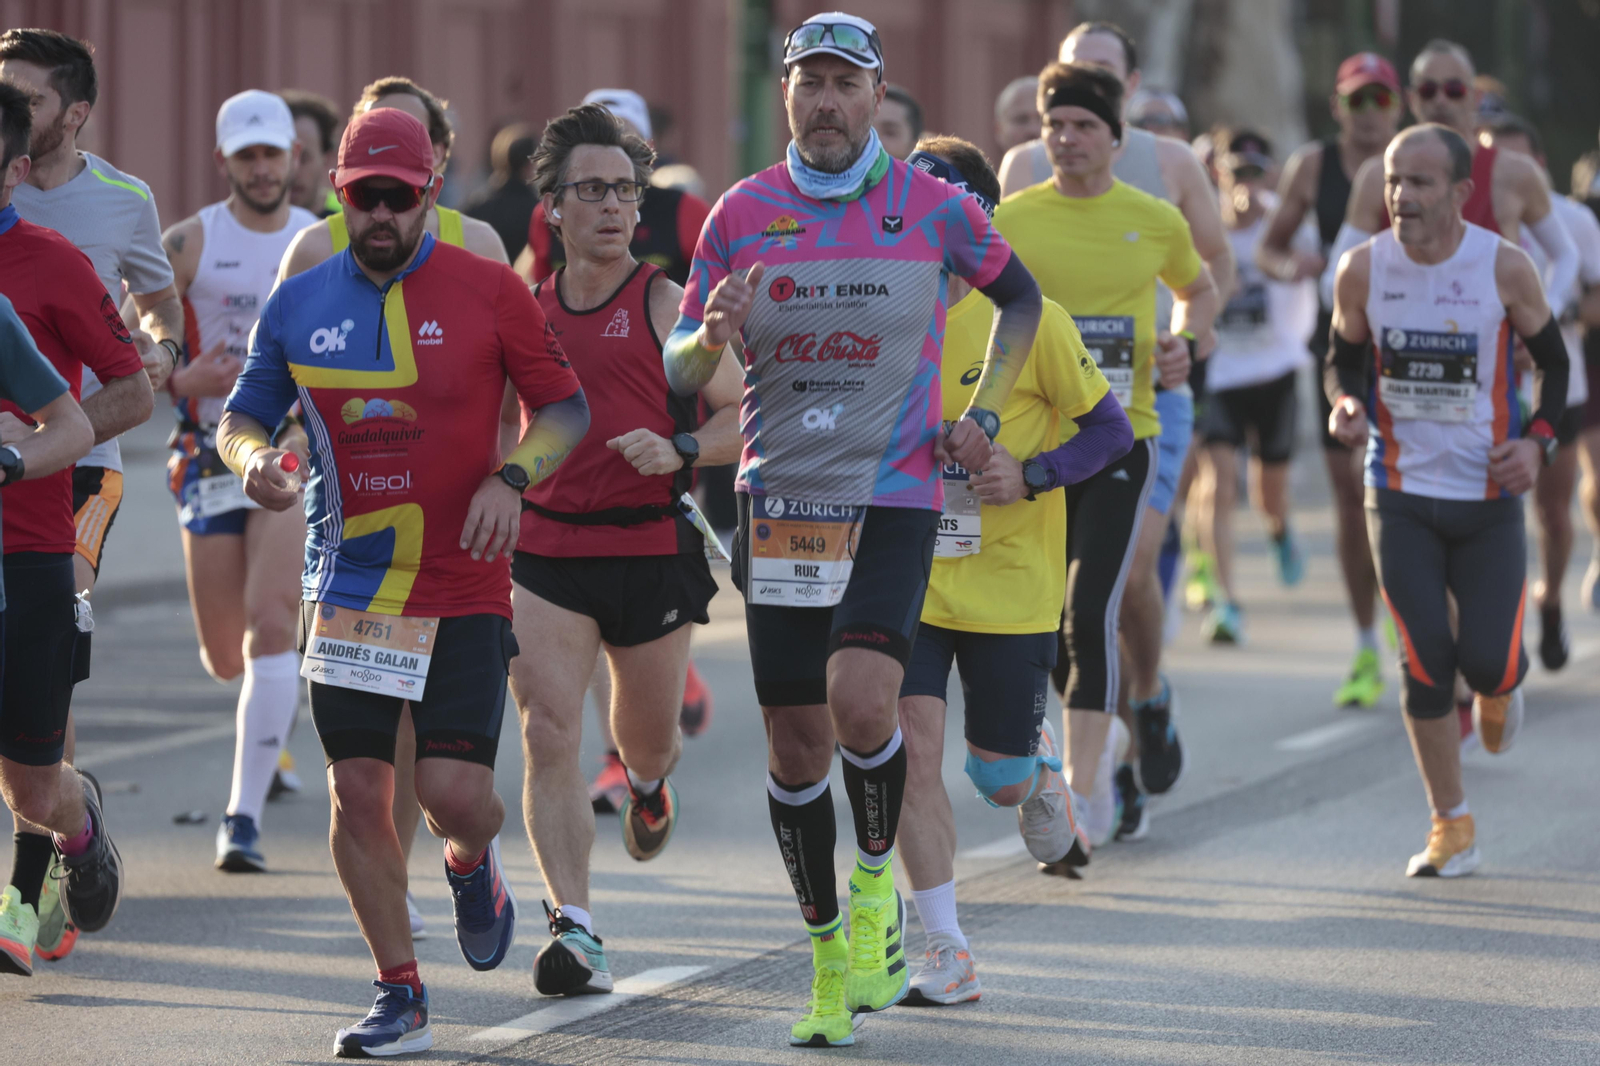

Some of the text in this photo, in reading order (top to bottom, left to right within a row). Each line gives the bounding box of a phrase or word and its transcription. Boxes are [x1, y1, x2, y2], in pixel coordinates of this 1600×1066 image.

[770, 277, 889, 301] TRITIENDA
[417, 336, 443, 345] mobel
[775, 331, 883, 364] Me Gusta
[1409, 334, 1467, 350] ZURICH
[337, 426, 425, 445] Guadalquivir
[349, 470, 410, 491] Visol
[788, 500, 853, 517] ZURICH
[790, 535, 826, 553] 5449
[794, 564, 820, 578] RUIZ
[353, 620, 393, 640] 4751
[317, 641, 419, 671] ANDRÉS GALAN
